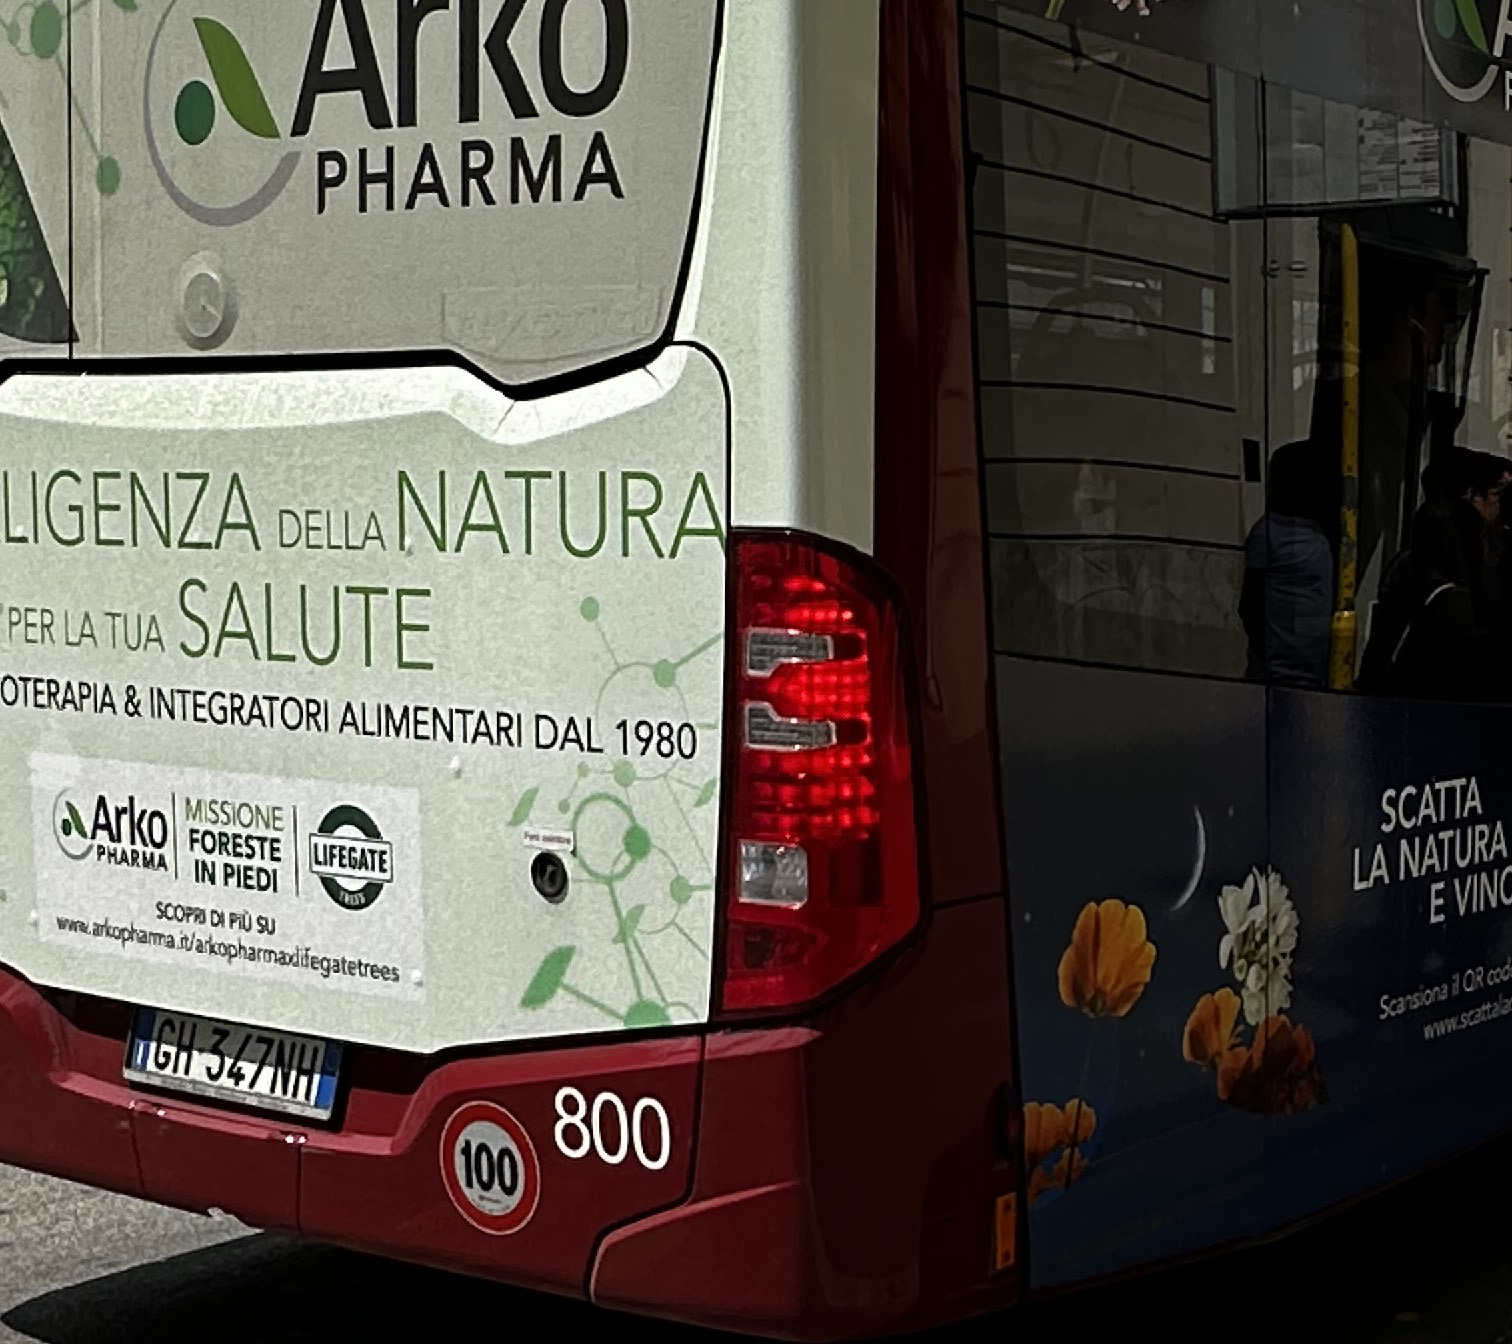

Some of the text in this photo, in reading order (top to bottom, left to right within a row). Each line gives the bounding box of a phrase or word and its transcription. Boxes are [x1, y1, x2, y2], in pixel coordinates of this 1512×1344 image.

[317, 130, 625, 215] PHARMA
[277, 508, 387, 553] DELLA
[397, 469, 726, 560] NATURA
[8, 577, 434, 672] PER LA TUA SALUTE
[0, 674, 698, 762] OTERAPIA & INTEGRATORI ALIMENTARI DAL 1980
[90, 793, 168, 850] Arko
[184, 796, 285, 832] MISSIONE
[1379, 776, 1483, 834] SCATTA
[96, 844, 168, 872] PHARMA
[188, 828, 283, 863] FORESTE
[312, 842, 389, 875] LIFEGATE
[1353, 820, 1508, 892] LA NATURA
[193, 859, 279, 894] IN PIEDI
[1429, 881, 1446, 925] E
[155, 900, 207, 925] SCOPRI
[210, 909, 222, 929] DI
[256, 917, 276, 936] SU
[1379, 981, 1449, 1021] Scansiona
[1462, 965, 1485, 993] QR
[154, 1018, 197, 1077] GH
[205, 1026, 319, 1102] 347NH
[554, 1086, 671, 1170] 800
[461, 1139, 518, 1197] 100
